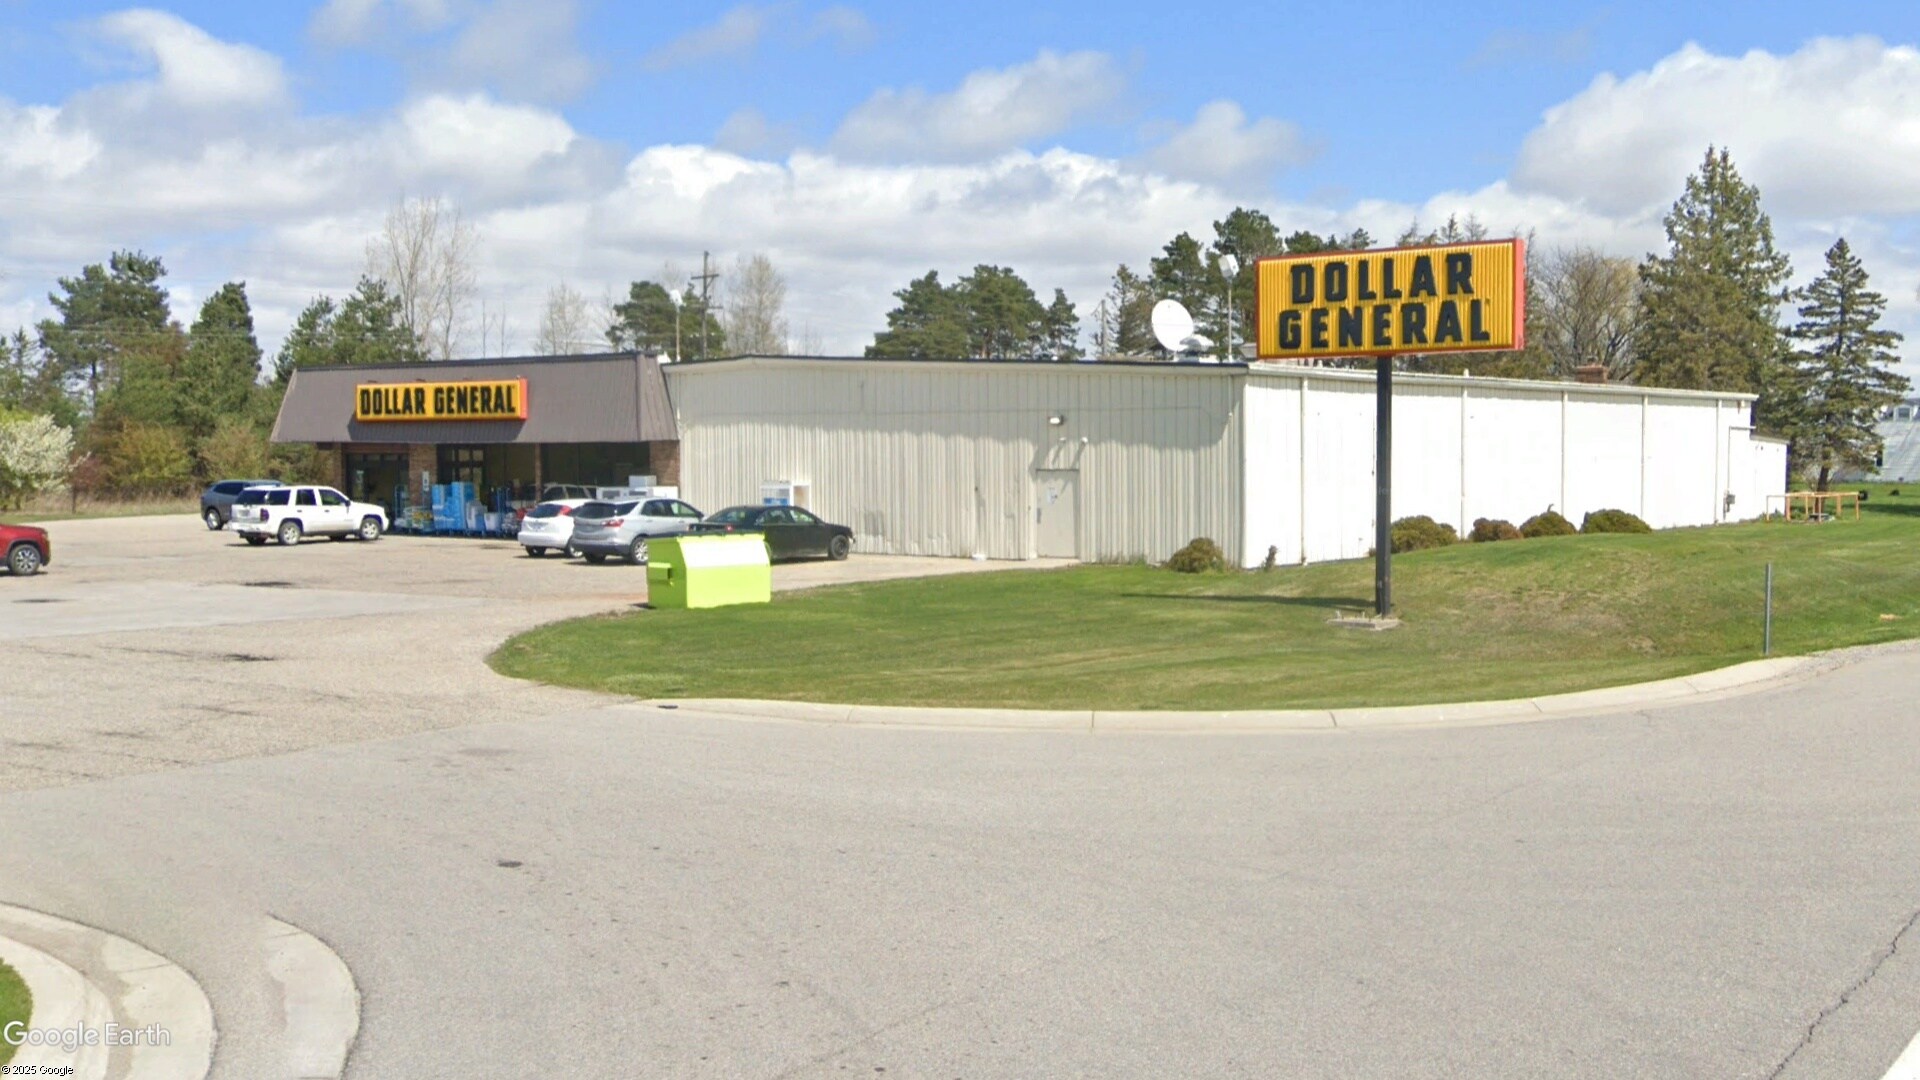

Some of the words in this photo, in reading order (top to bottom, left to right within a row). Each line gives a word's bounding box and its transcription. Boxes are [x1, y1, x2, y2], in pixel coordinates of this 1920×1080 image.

[1291, 253, 1474, 304] DOLLAR
[1278, 298, 1490, 350] GENERAL
[360, 387, 426, 415] DOLLAR
[433, 385, 515, 415] GENERAL
